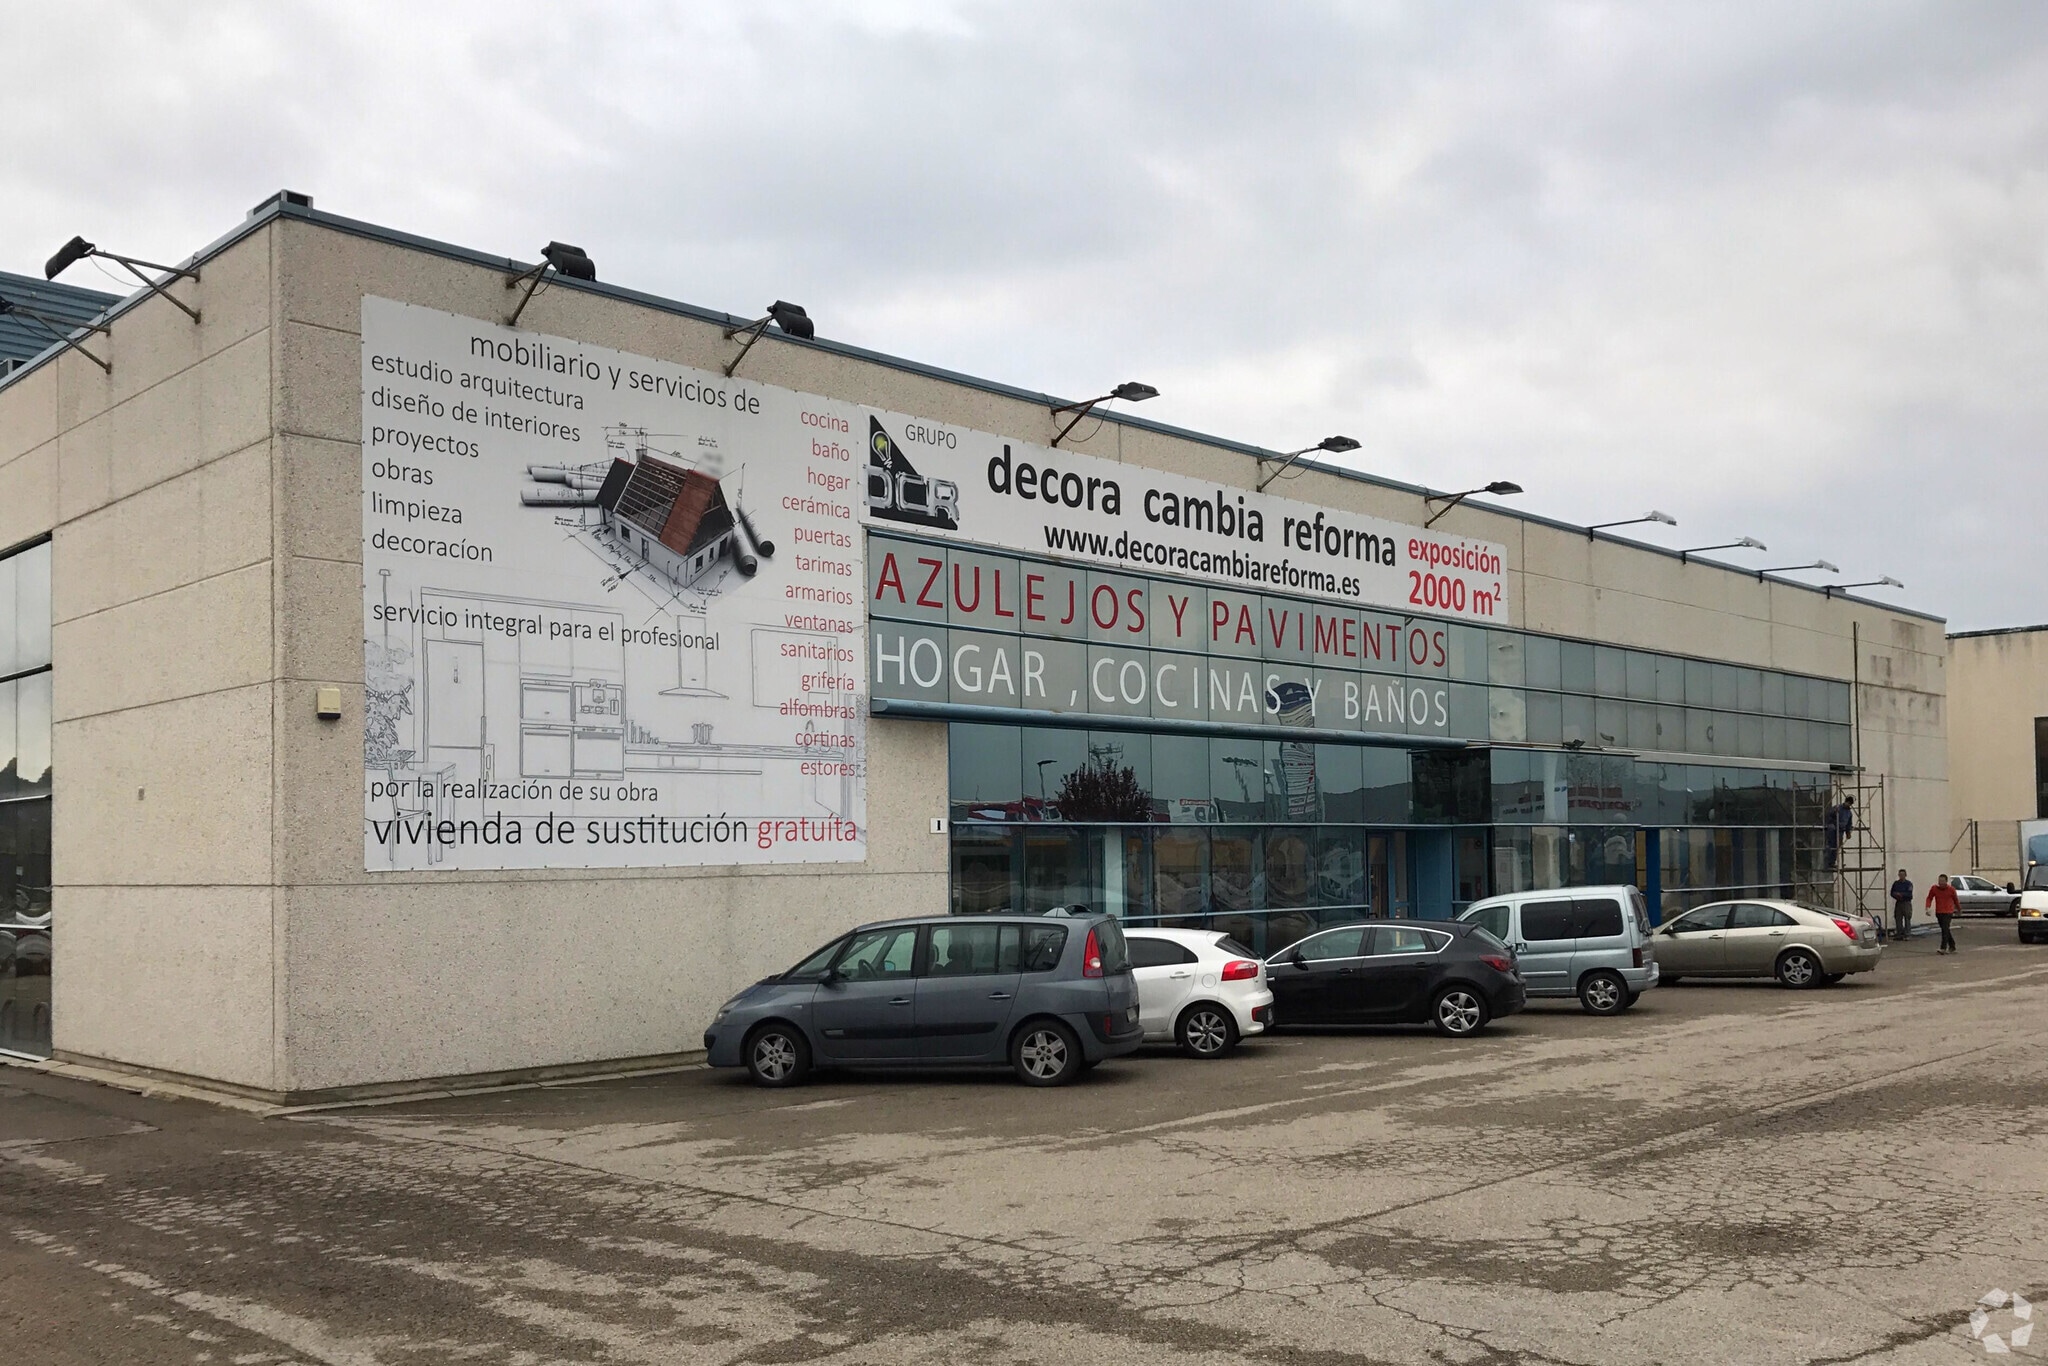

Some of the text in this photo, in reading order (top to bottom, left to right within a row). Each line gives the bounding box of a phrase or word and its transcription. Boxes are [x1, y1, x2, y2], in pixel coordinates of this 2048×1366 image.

[372, 353, 584, 411] estudio arquitectura
[470, 334, 761, 415] mobiliario y servicios de
[372, 387, 580, 443] diseño de interiores
[801, 411, 849, 432] cocina
[372, 425, 479, 458] proyectos
[811, 437, 850, 461] baño
[905, 424, 957, 449] GRUPO
[372, 459, 433, 486] obras
[807, 465, 850, 491] hogar
[372, 492, 462, 530] limpieza
[782, 494, 850, 518] cerámica
[988, 444, 1397, 567] decora cambia reforma
[372, 528, 492, 562] decoracíon
[794, 524, 852, 549] puertas
[796, 553, 852, 577] tarimas
[1044, 525, 1361, 597] www.decoracambiareforma.es
[1408, 536, 1500, 576] exposición
[786, 583, 853, 606] armarios
[1409, 569, 1466, 611] 2000
[875, 552, 1446, 667] AZULEJOS Y PAVIMENTOS
[373, 602, 720, 651] servicio integral para el profesional
[785, 613, 854, 634] ventanas
[780, 642, 854, 662] sanitarios
[802, 670, 855, 694] grifería
[875, 633, 1047, 699] HOGAR
[1092, 657, 1281, 715] COCINAS
[1306, 677, 1322, 716] Y
[1344, 679, 1448, 727] BAÑOS
[780, 699, 856, 720] alfombras
[795, 729, 856, 749] cortinas
[801, 759, 856, 777] estores
[371, 779, 658, 803] por la realización de su obra
[372, 810, 857, 849] vivienda de sustitución gratuíta
